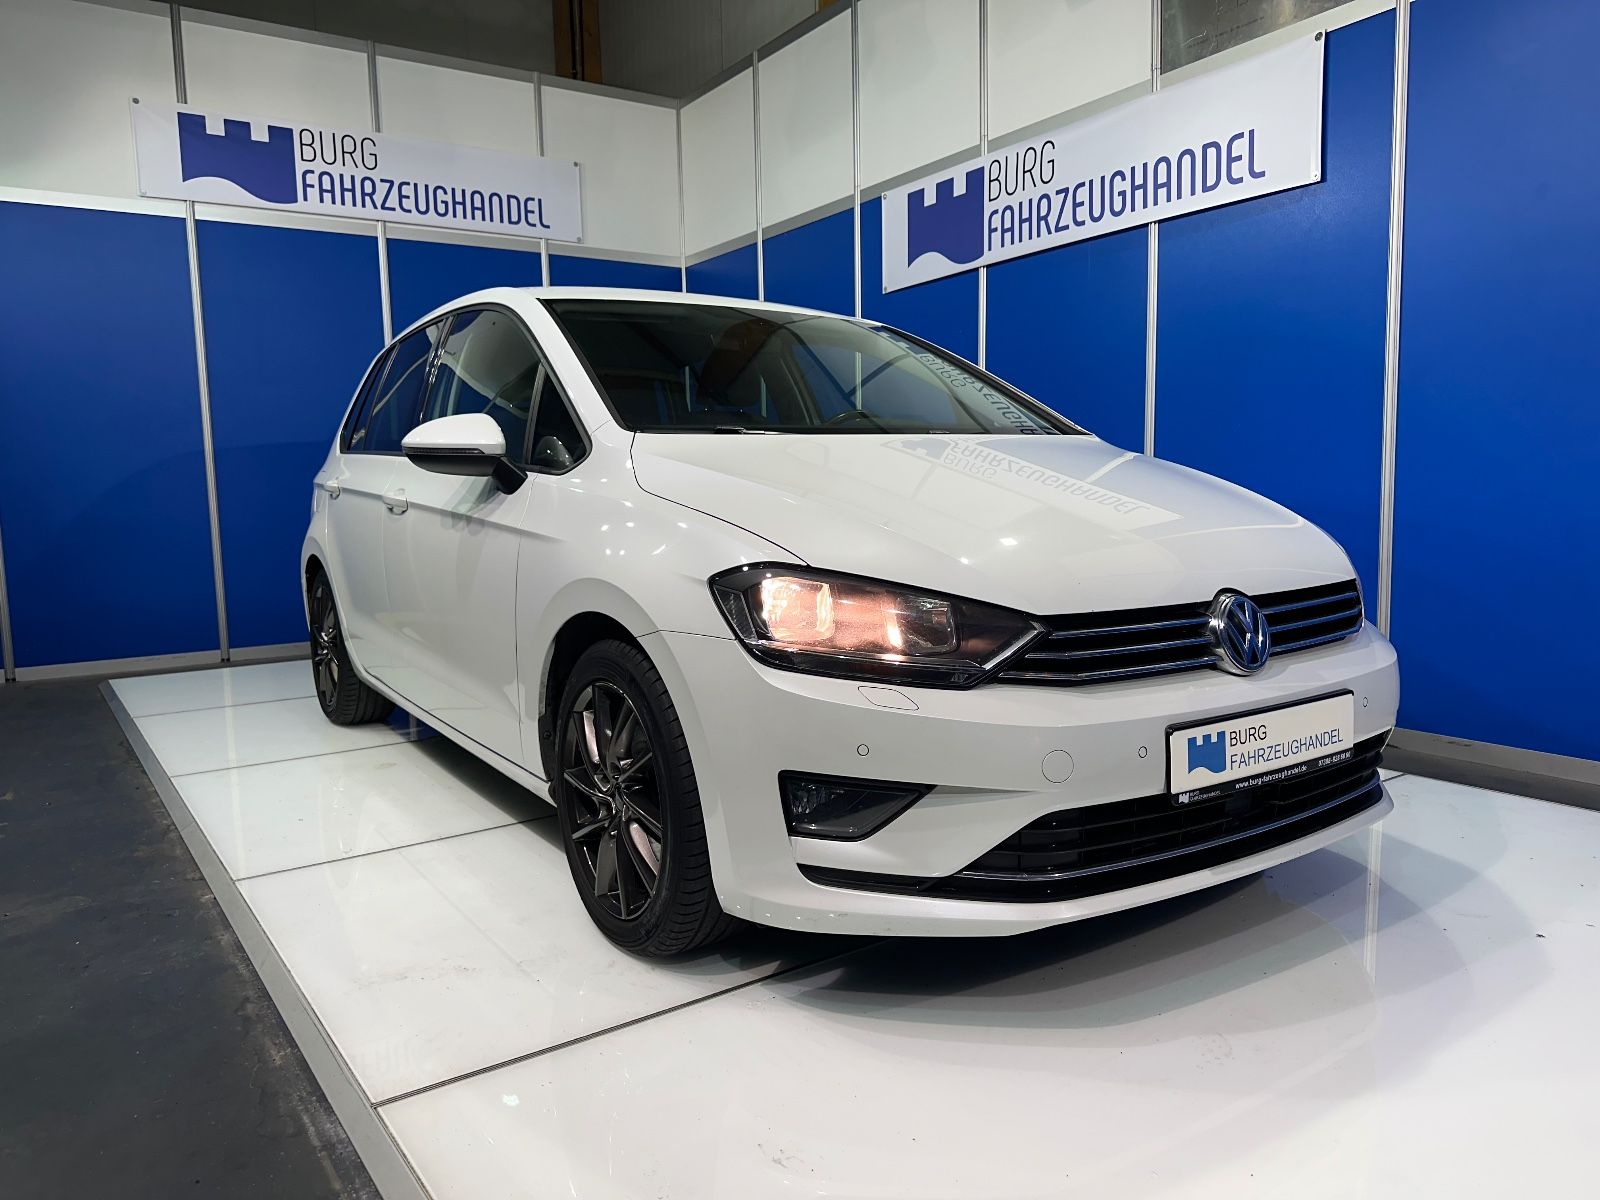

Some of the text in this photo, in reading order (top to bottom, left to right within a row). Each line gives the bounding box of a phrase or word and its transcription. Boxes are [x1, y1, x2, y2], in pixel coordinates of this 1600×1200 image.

[300, 128, 378, 171] BURG
[988, 140, 1056, 203] BURG
[302, 169, 551, 229] FAHRZEUGHANDEL
[987, 128, 1266, 252] FAHRZEUGHANDEL
[1229, 724, 1267, 747] BURG
[1230, 728, 1343, 771] FAHRZEUGHANDEL
